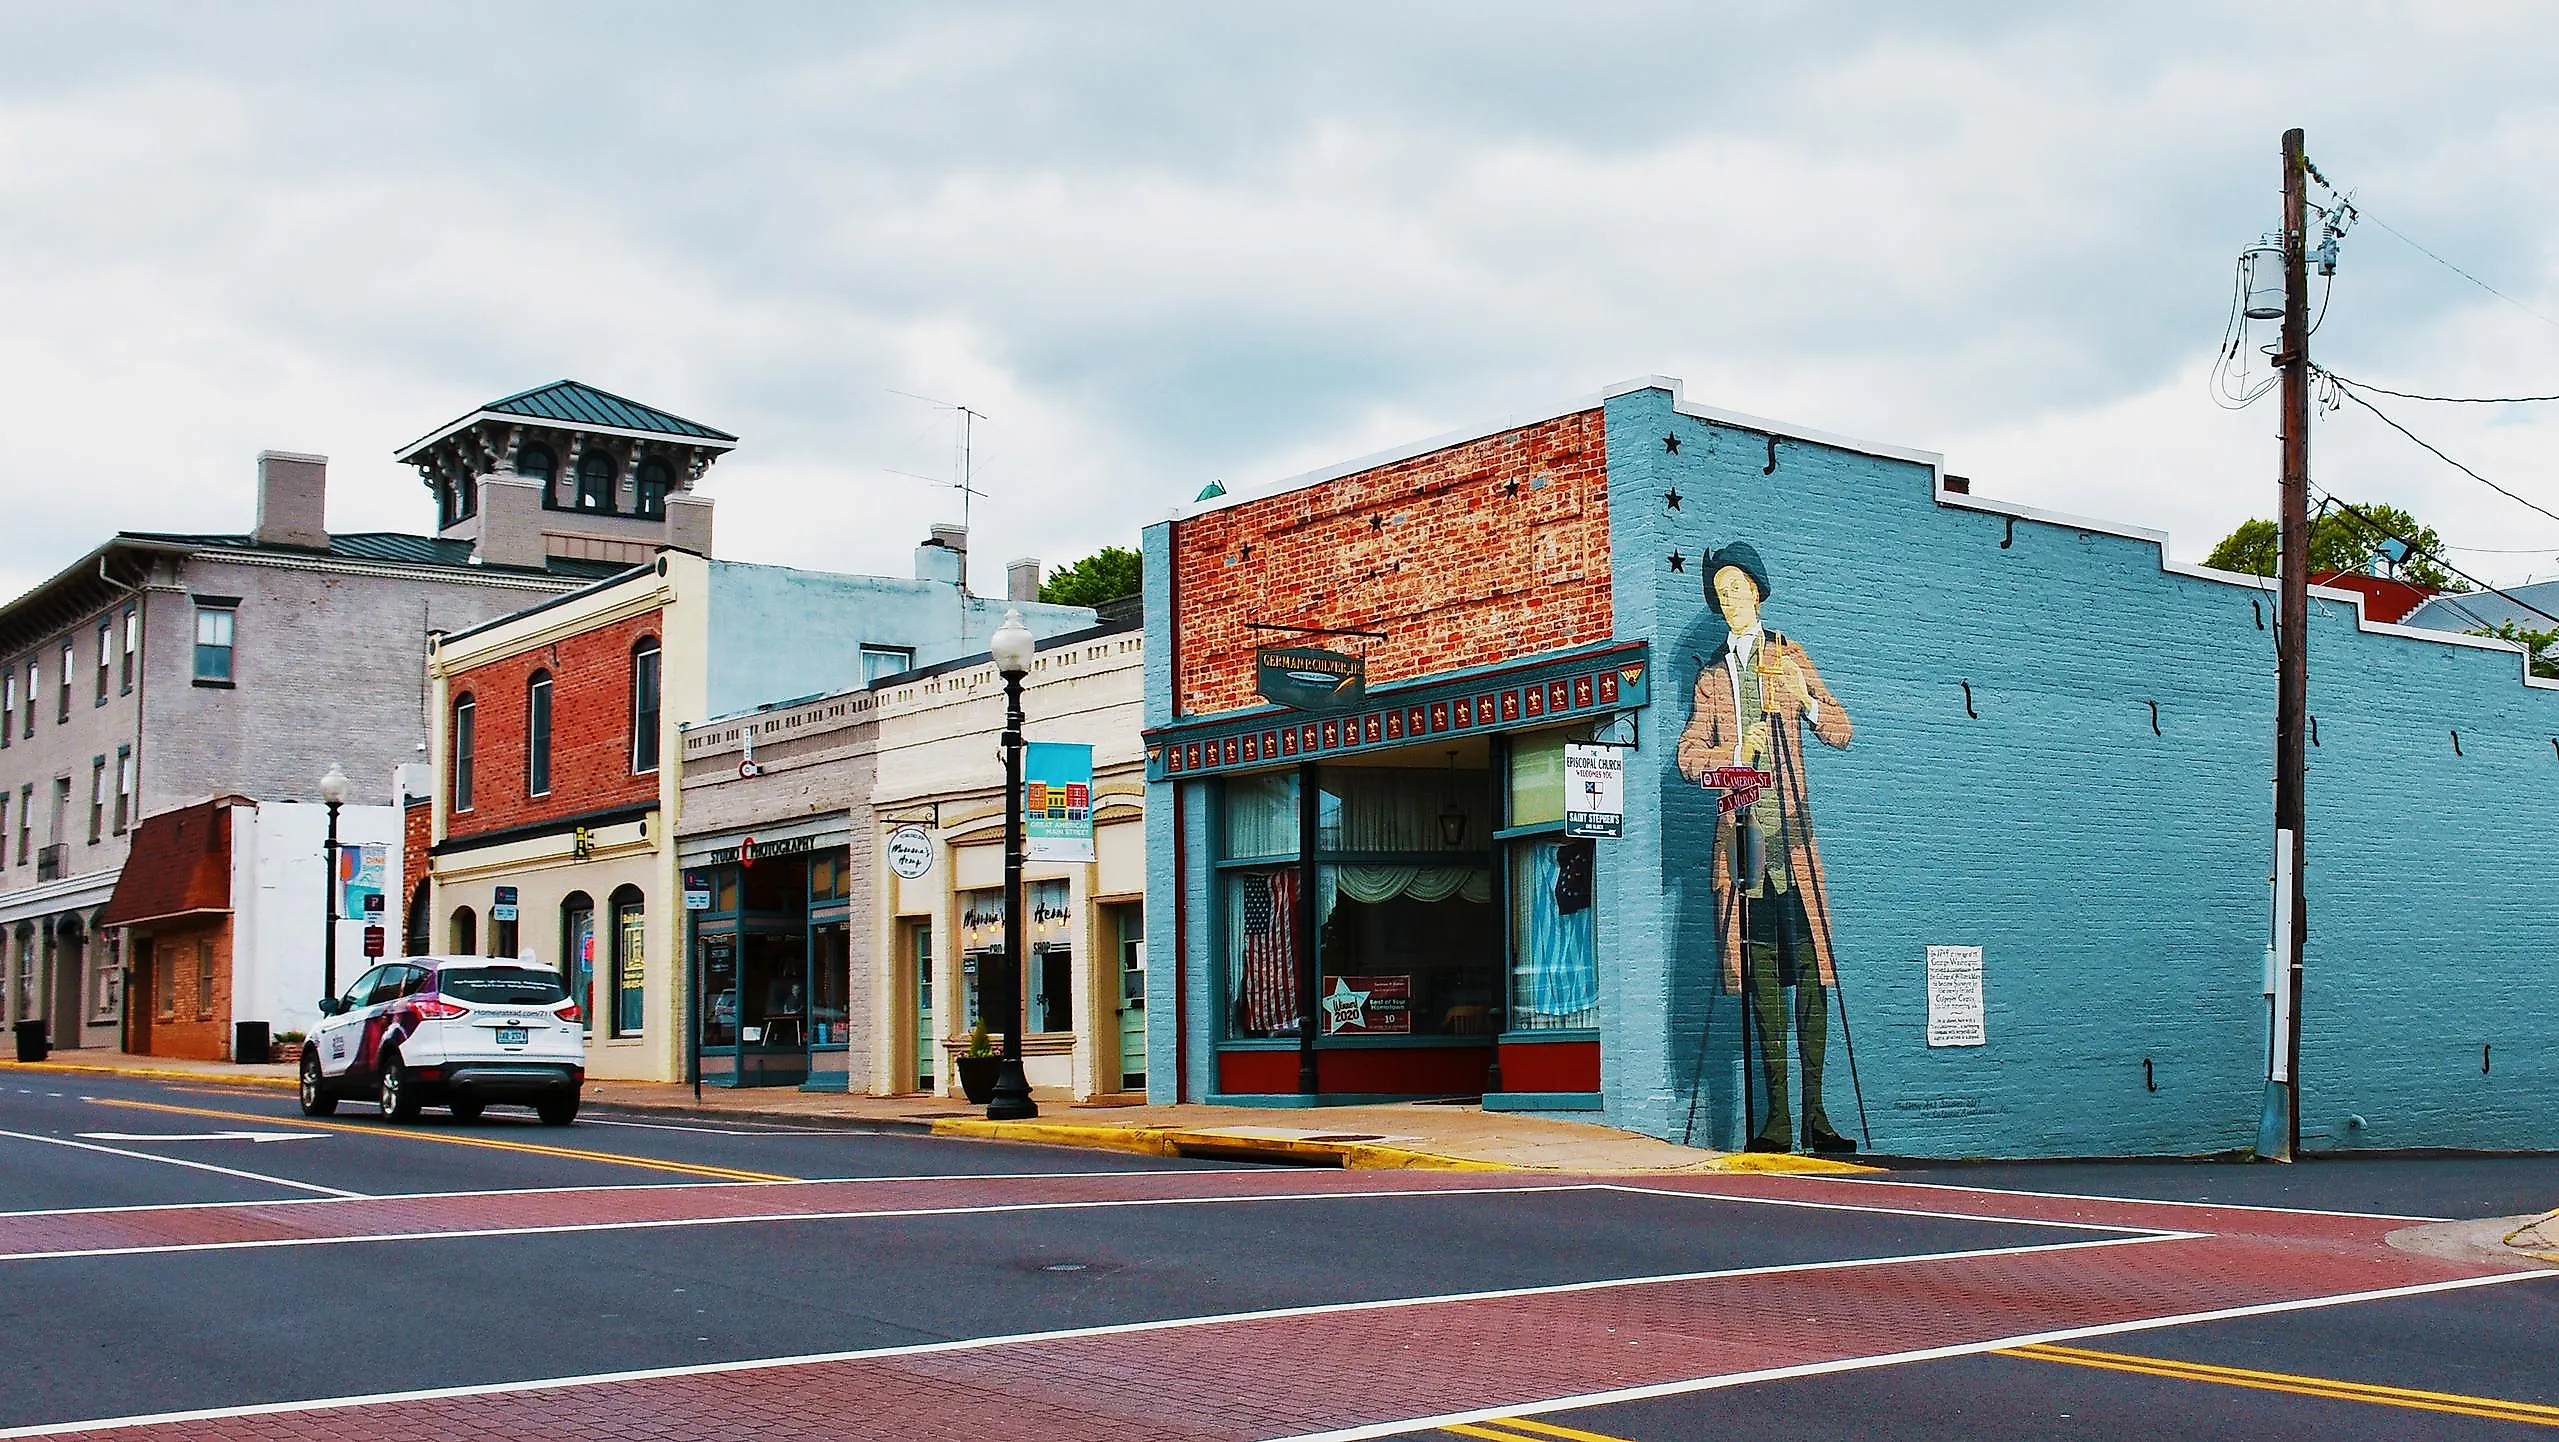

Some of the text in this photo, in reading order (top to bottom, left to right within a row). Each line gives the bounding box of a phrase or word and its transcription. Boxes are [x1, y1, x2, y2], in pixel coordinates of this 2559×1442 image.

[1263, 654, 1304, 670] GERMAN
[1567, 757, 1621, 771] EPISCOPAL CHURCH
[1576, 770, 1601, 778] WELCOMES
[1723, 773, 1757, 787] CAMERON
[1569, 813, 1620, 825] SAINT STEPHEN'S
[711, 849, 740, 864] STUDIO
[751, 836, 816, 858] PHOTOGRAPHY
[899, 854, 921, 868] Hemp
[1034, 902, 1071, 927] Hemp
[1335, 1010, 1359, 1022] 2020
[1385, 1014, 1395, 1023] 10
